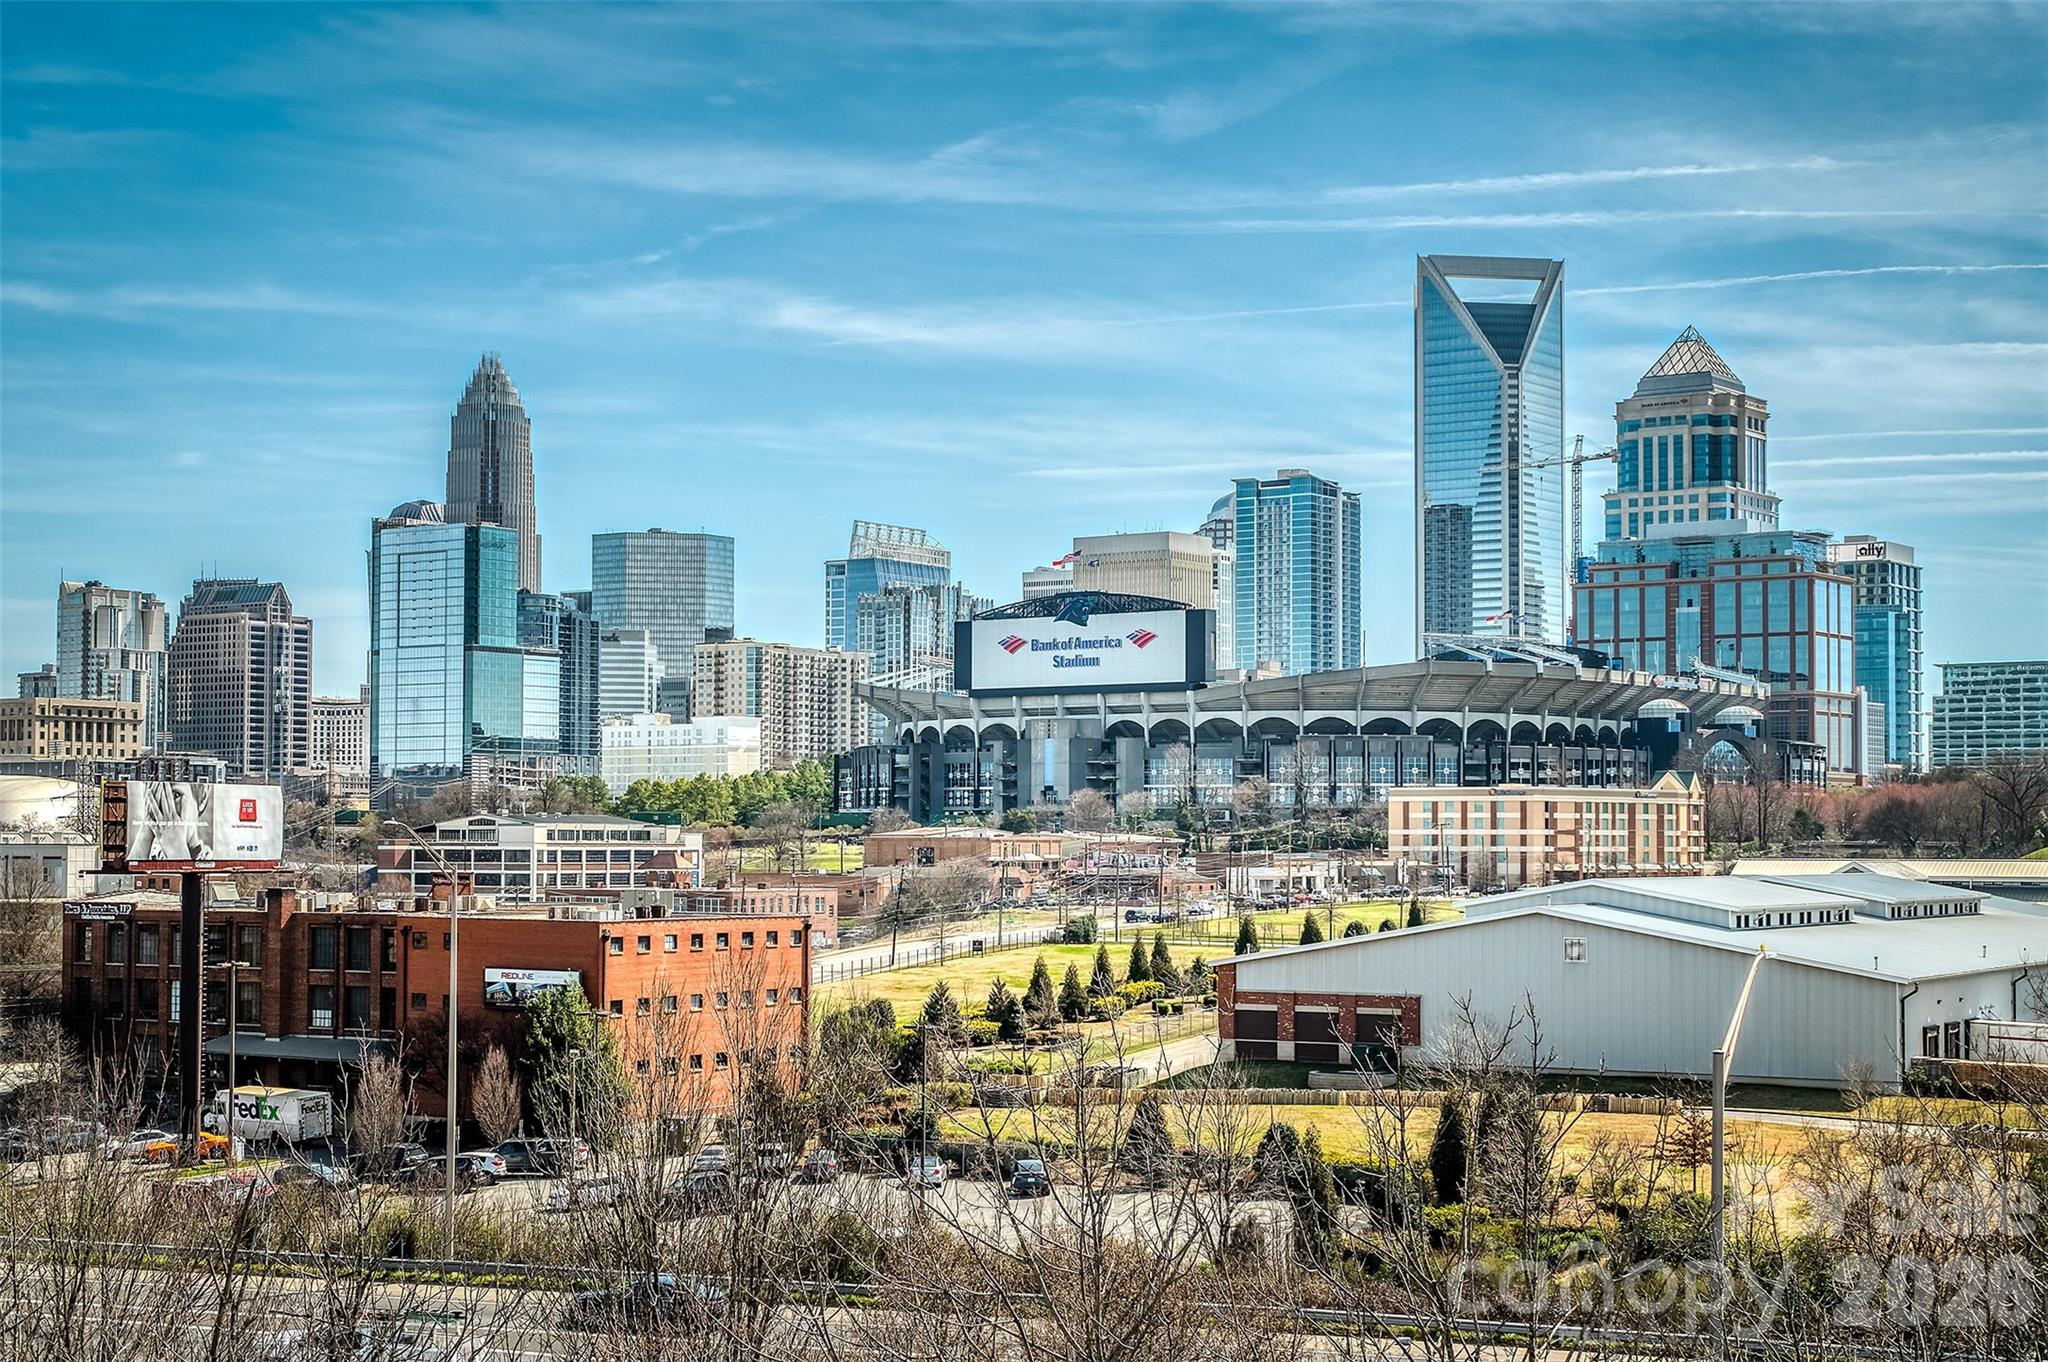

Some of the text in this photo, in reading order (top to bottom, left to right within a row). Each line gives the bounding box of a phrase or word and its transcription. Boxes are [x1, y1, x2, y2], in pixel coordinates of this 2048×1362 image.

[1859, 543, 1884, 558] ally
[1031, 635, 1122, 652] Bank of America
[1052, 654, 1101, 669] Stadium
[501, 971, 535, 981] REDLINE
[301, 1100, 328, 1115] FedEx
